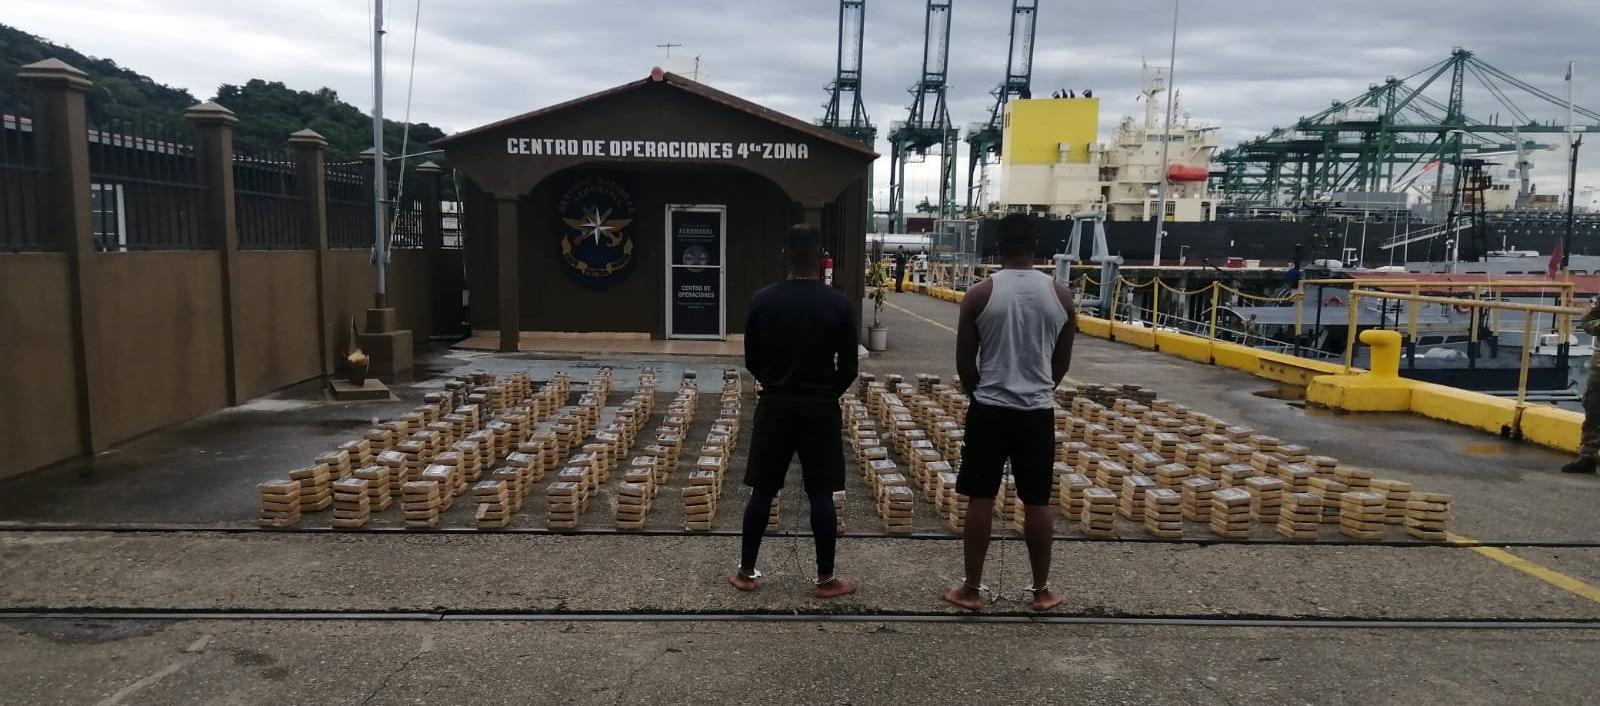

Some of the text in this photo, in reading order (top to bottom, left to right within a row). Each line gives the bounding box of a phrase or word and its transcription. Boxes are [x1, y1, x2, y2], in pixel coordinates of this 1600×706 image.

[507, 138, 578, 155] CENTRO
[582, 139, 606, 156] DE
[609, 140, 733, 158] OPERACIONES
[762, 143, 809, 159] ZONA
